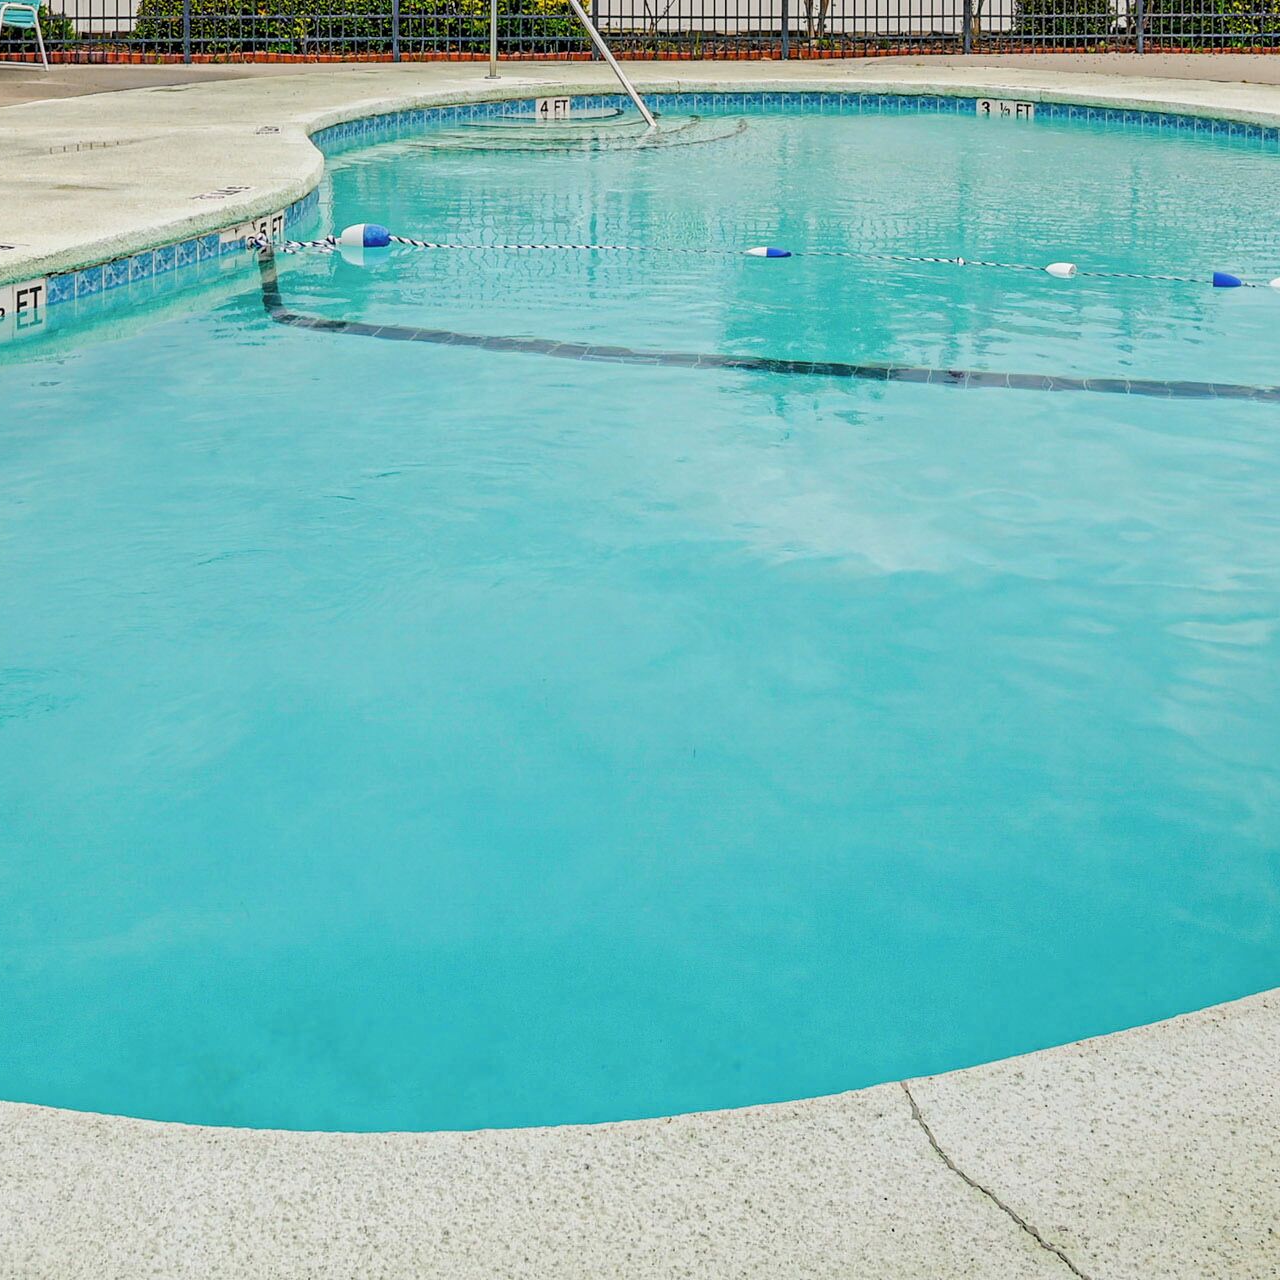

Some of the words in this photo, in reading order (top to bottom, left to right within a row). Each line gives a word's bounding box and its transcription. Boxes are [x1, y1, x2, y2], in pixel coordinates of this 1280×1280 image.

[540, 100, 548, 112] 4
[554, 100, 569, 114] FT
[981, 101, 990, 114] 3
[1016, 103, 1032, 120] FT
[272, 215, 283, 236] FT
[16, 286, 43, 314] FT
